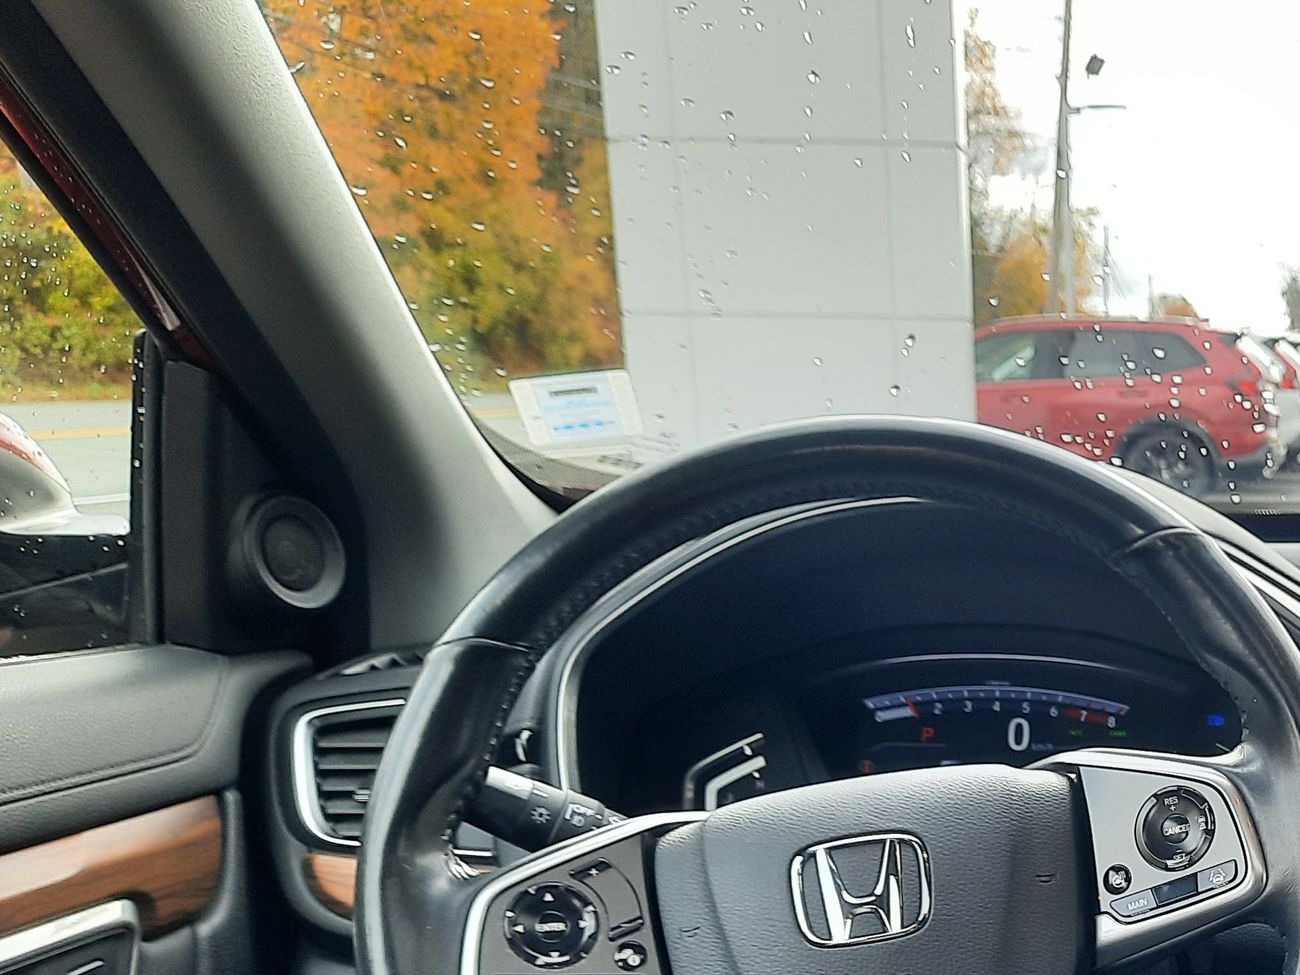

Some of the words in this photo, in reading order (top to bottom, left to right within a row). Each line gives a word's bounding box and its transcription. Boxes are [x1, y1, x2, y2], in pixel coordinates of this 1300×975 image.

[963, 701, 973, 713] 3
[992, 701, 1001, 712] 4
[1022, 702, 1031, 714] 5
[922, 728, 935, 741] P
[1007, 717, 1031, 751] 0
[1164, 796, 1179, 805] RES
[1127, 898, 1149, 911] MAIN
